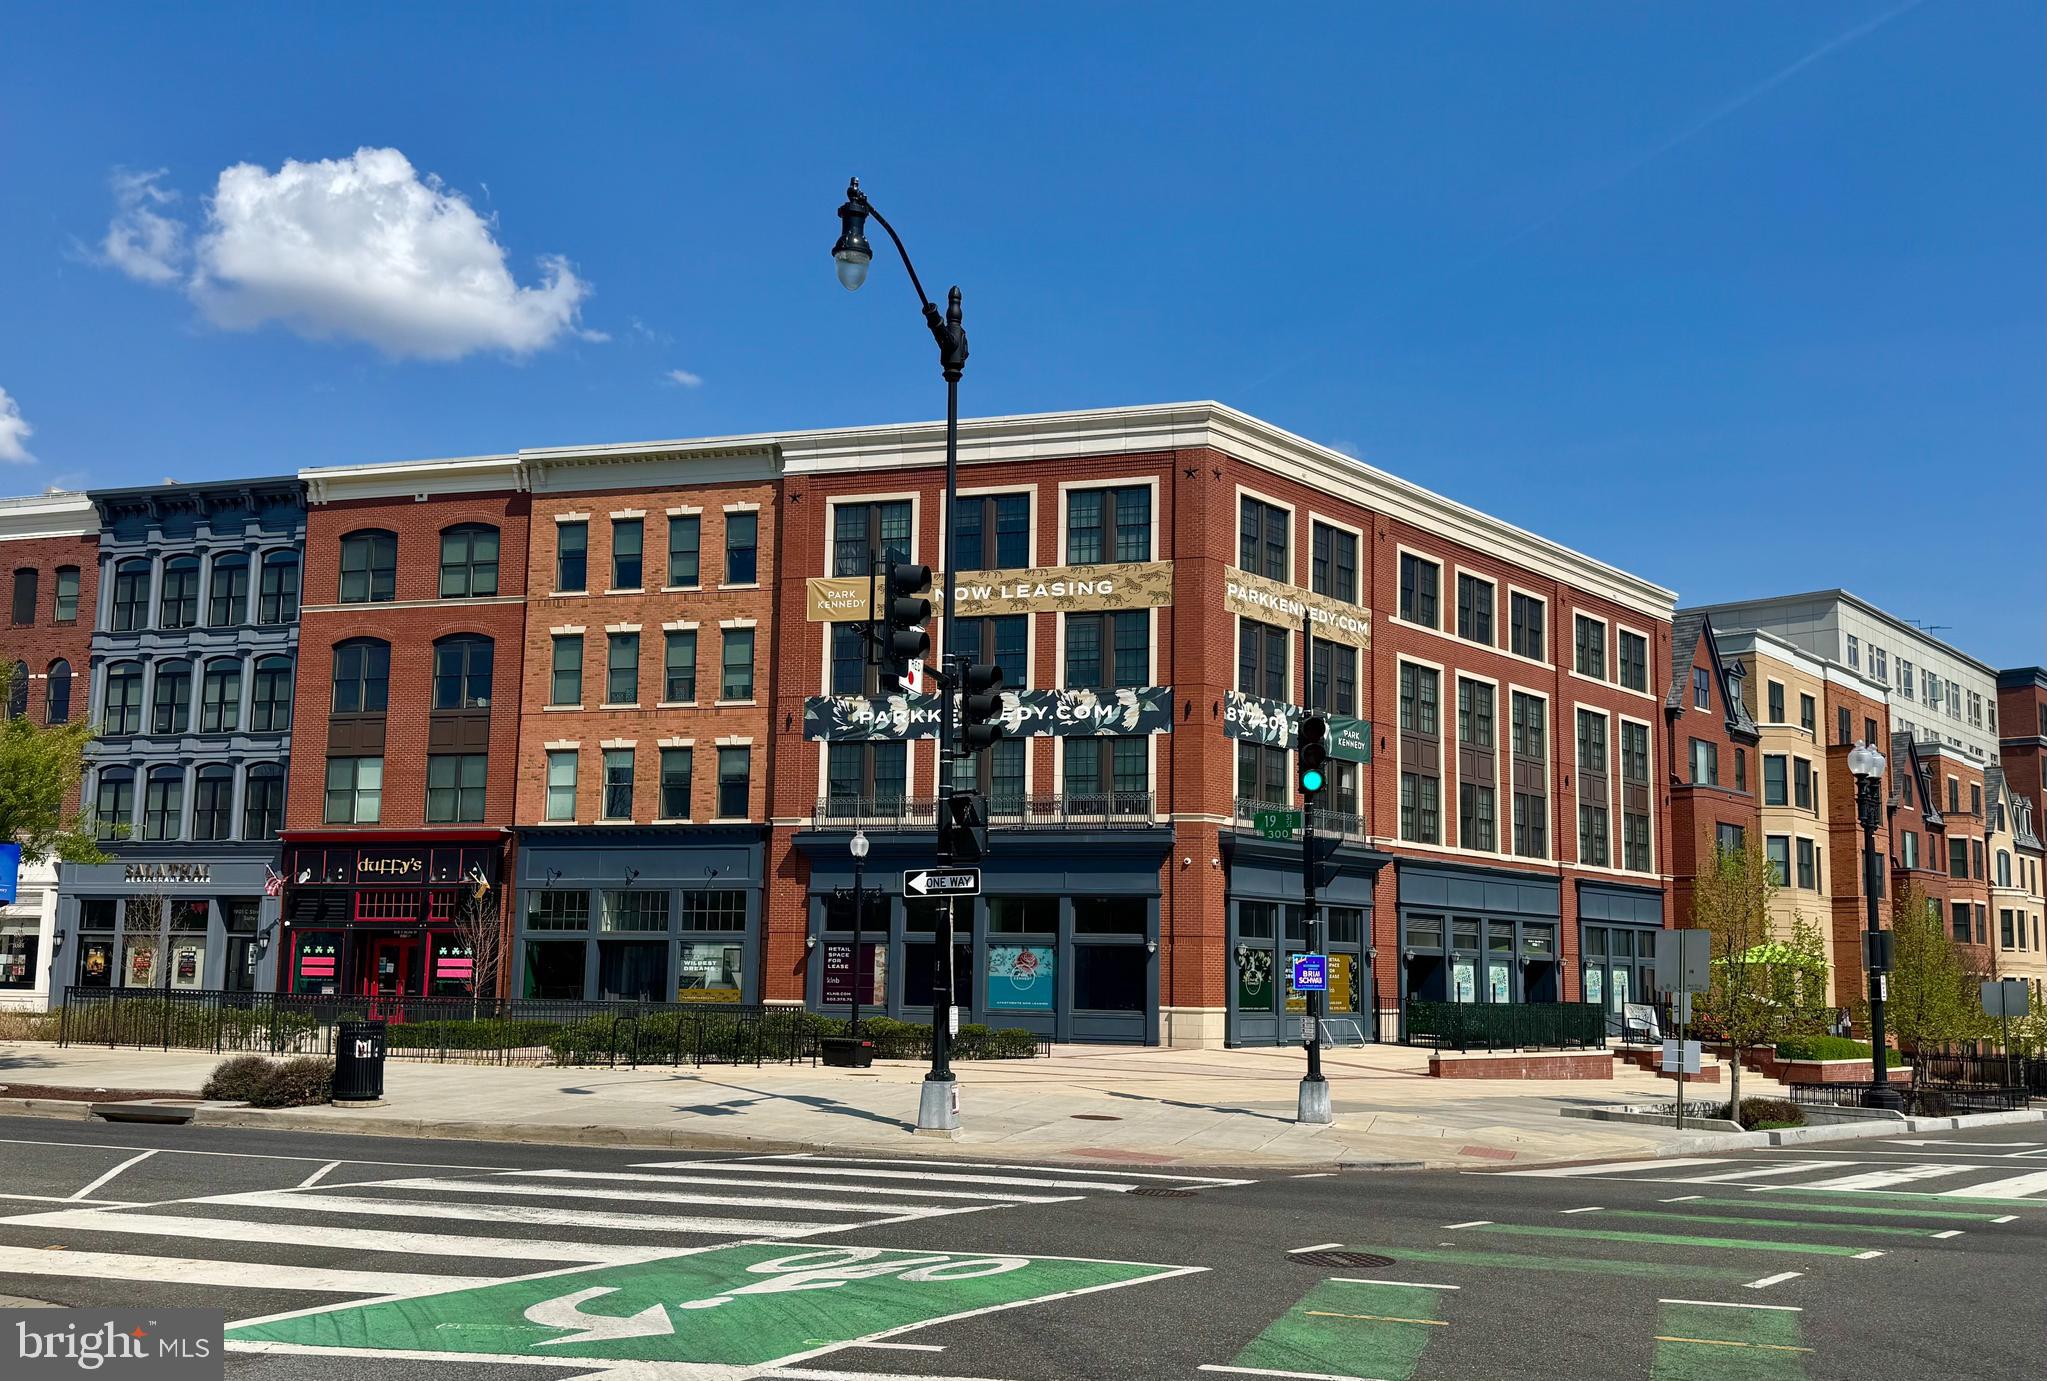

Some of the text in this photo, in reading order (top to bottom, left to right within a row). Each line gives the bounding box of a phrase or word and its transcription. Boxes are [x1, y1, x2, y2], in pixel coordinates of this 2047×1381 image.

[828, 590, 856, 599] PARK
[1001, 580, 1113, 599] LEASING
[817, 599, 866, 609] KENNEDY
[1343, 729, 1361, 741] PARK
[1337, 737, 1366, 751] KENNEDY
[1264, 814, 1277, 828] 19
[1268, 829, 1289, 839] 300
[357, 857, 422, 875] duffy's
[926, 876, 972, 888] ONE WAY
